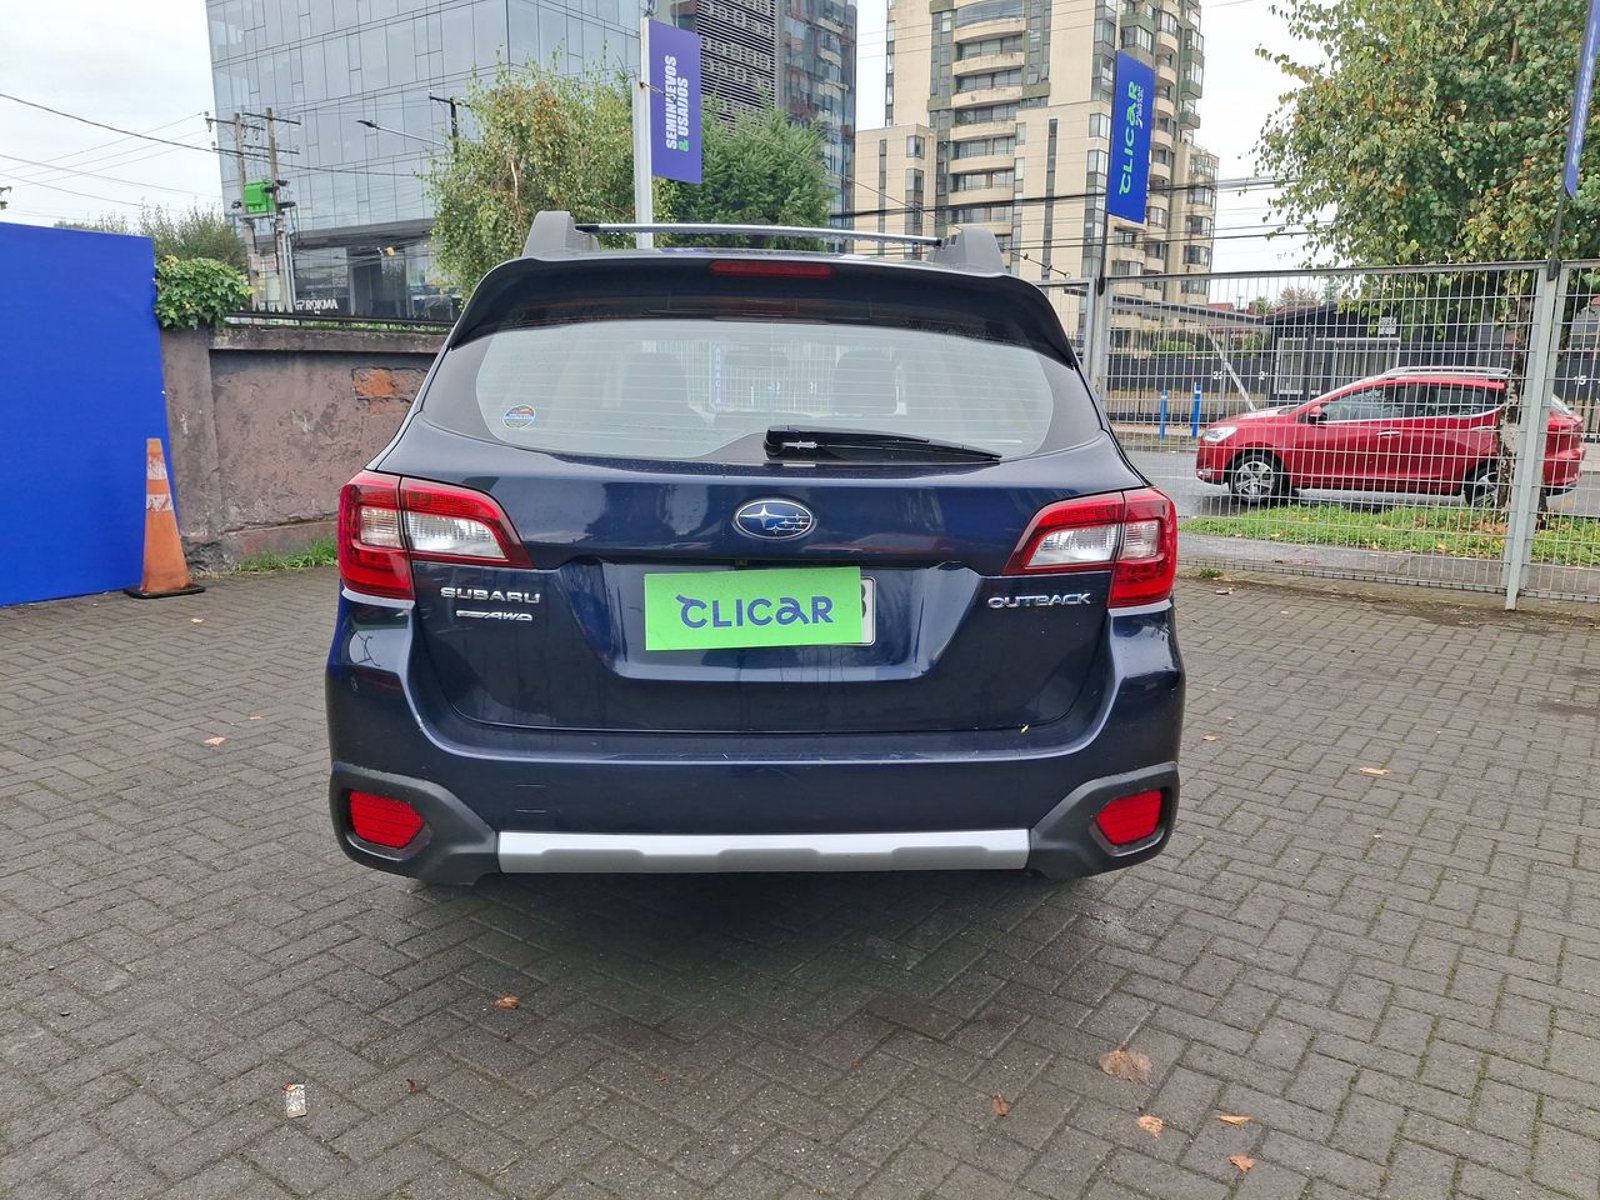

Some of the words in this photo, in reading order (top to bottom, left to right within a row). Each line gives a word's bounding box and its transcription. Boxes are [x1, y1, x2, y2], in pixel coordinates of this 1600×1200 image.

[665, 55, 677, 150] SEMINUEVOS
[678, 139, 689, 152] &
[440, 586, 541, 604] SUBARU
[987, 593, 1091, 609] OUTBACK
[484, 610, 533, 622] AWD
